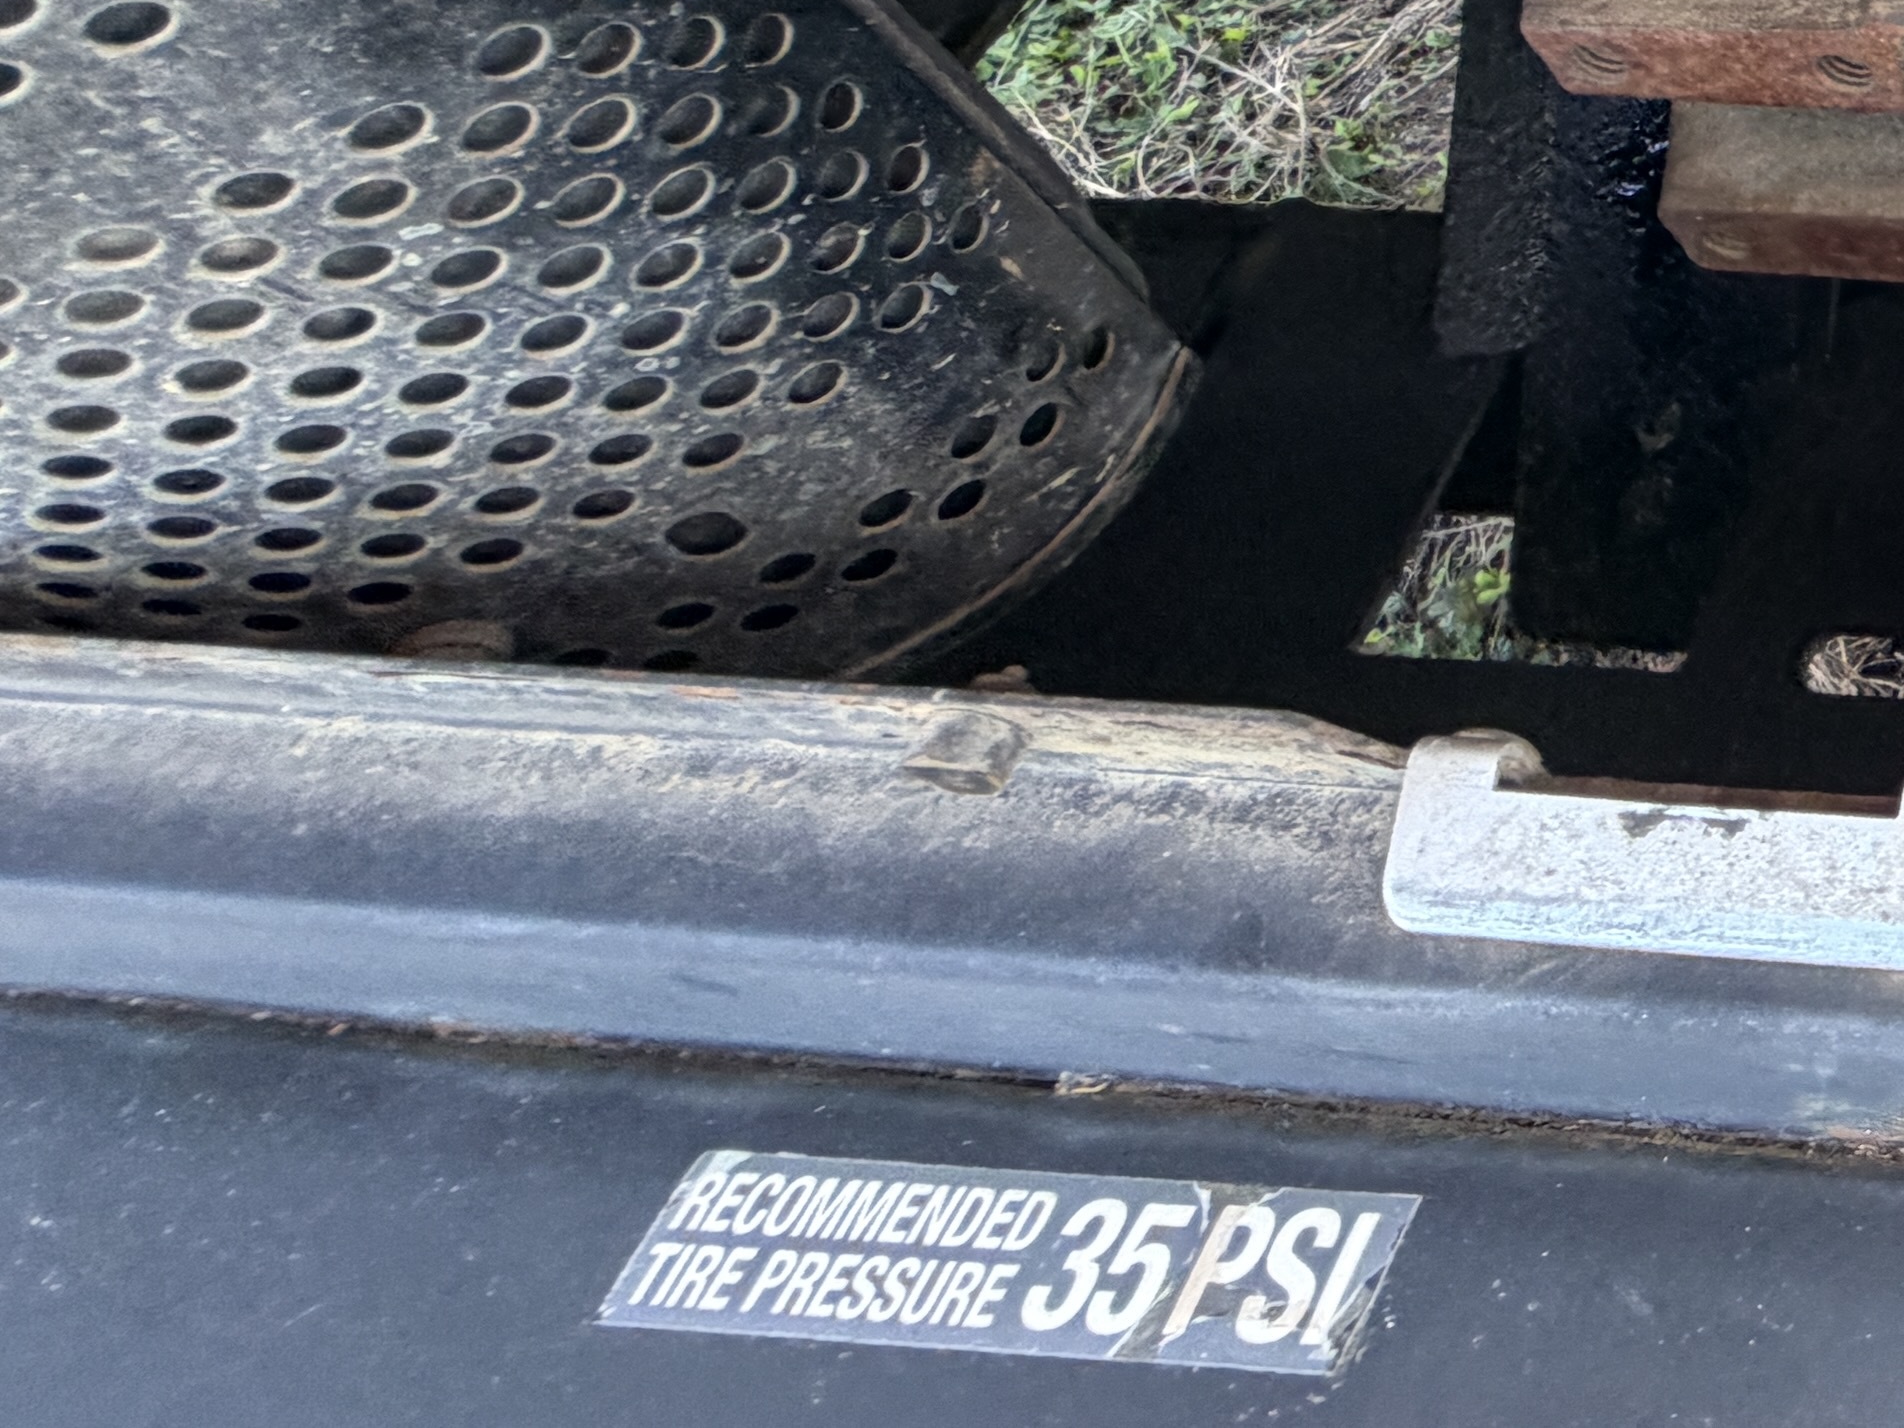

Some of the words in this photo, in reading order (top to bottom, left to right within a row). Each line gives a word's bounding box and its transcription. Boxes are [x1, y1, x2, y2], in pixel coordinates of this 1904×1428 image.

[667, 1170, 1060, 1253] RECOMMENDED
[626, 1242, 760, 1312] TIRE
[745, 1250, 1024, 1329] PRESSURE
[1021, 1197, 1196, 1337] 35
[1162, 1203, 1381, 1348] PSI
